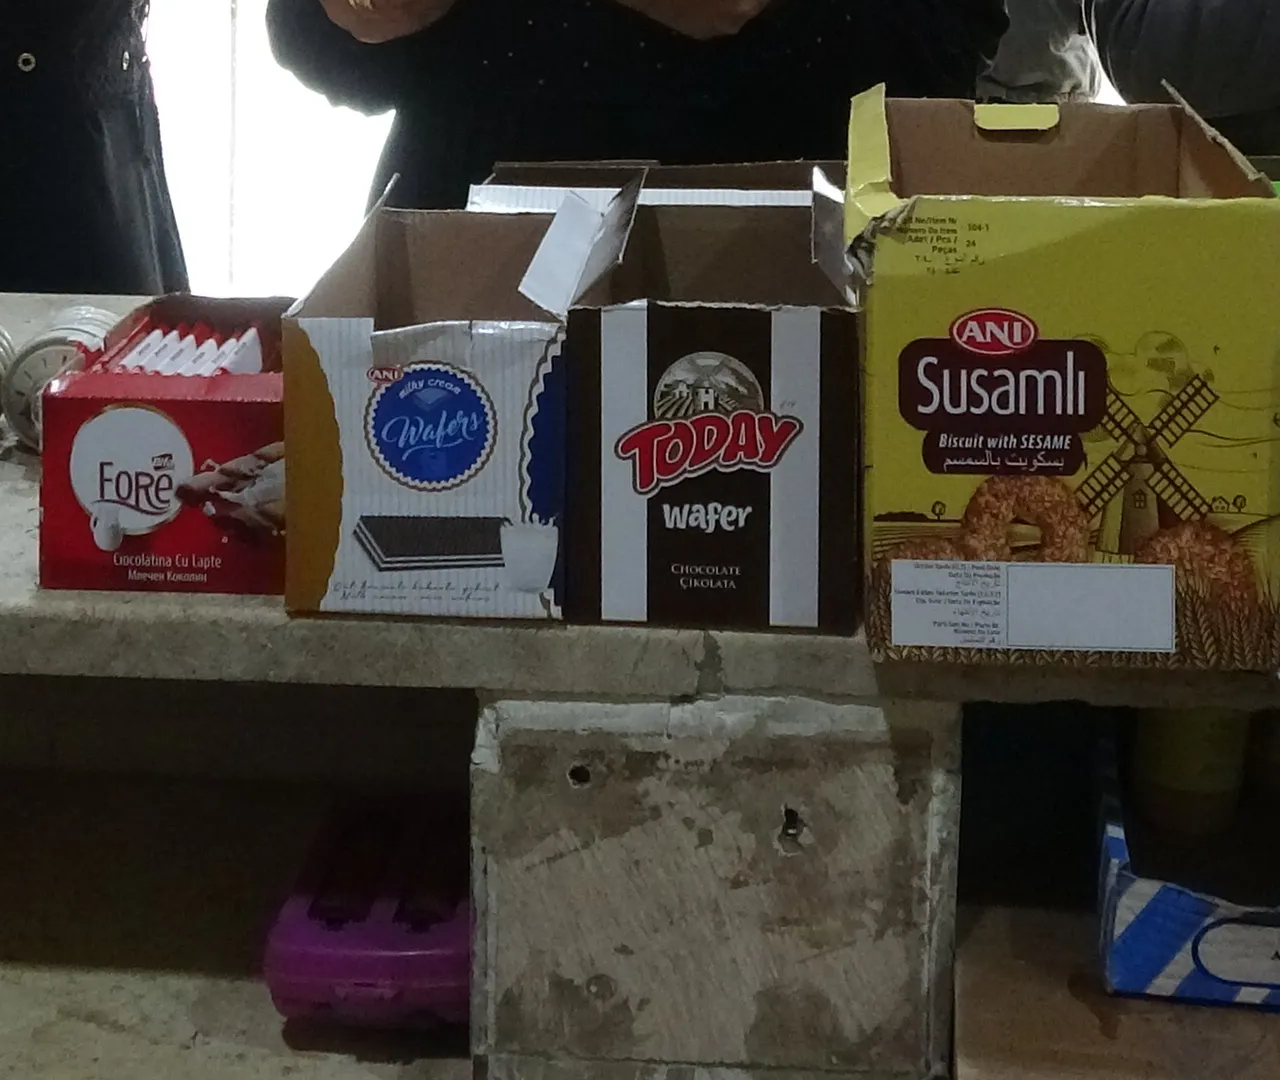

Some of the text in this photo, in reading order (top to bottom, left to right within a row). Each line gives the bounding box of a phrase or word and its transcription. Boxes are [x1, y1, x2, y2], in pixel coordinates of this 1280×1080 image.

[960, 320, 1023, 348] ANI
[371, 369, 400, 380] ANI
[917, 350, 1086, 415] Susamlı
[380, 410, 480, 449] Wafers
[938, 433, 1073, 450] Biscuit with SESAME
[617, 409, 802, 493] TODAY
[943, 449, 1065, 472] بسكويت بالسمسم
[662, 502, 753, 533] wafer
[175, 553, 189, 568] Cu
[192, 553, 223, 570] Lapte
[670, 563, 742, 577] CHOCOLATE
